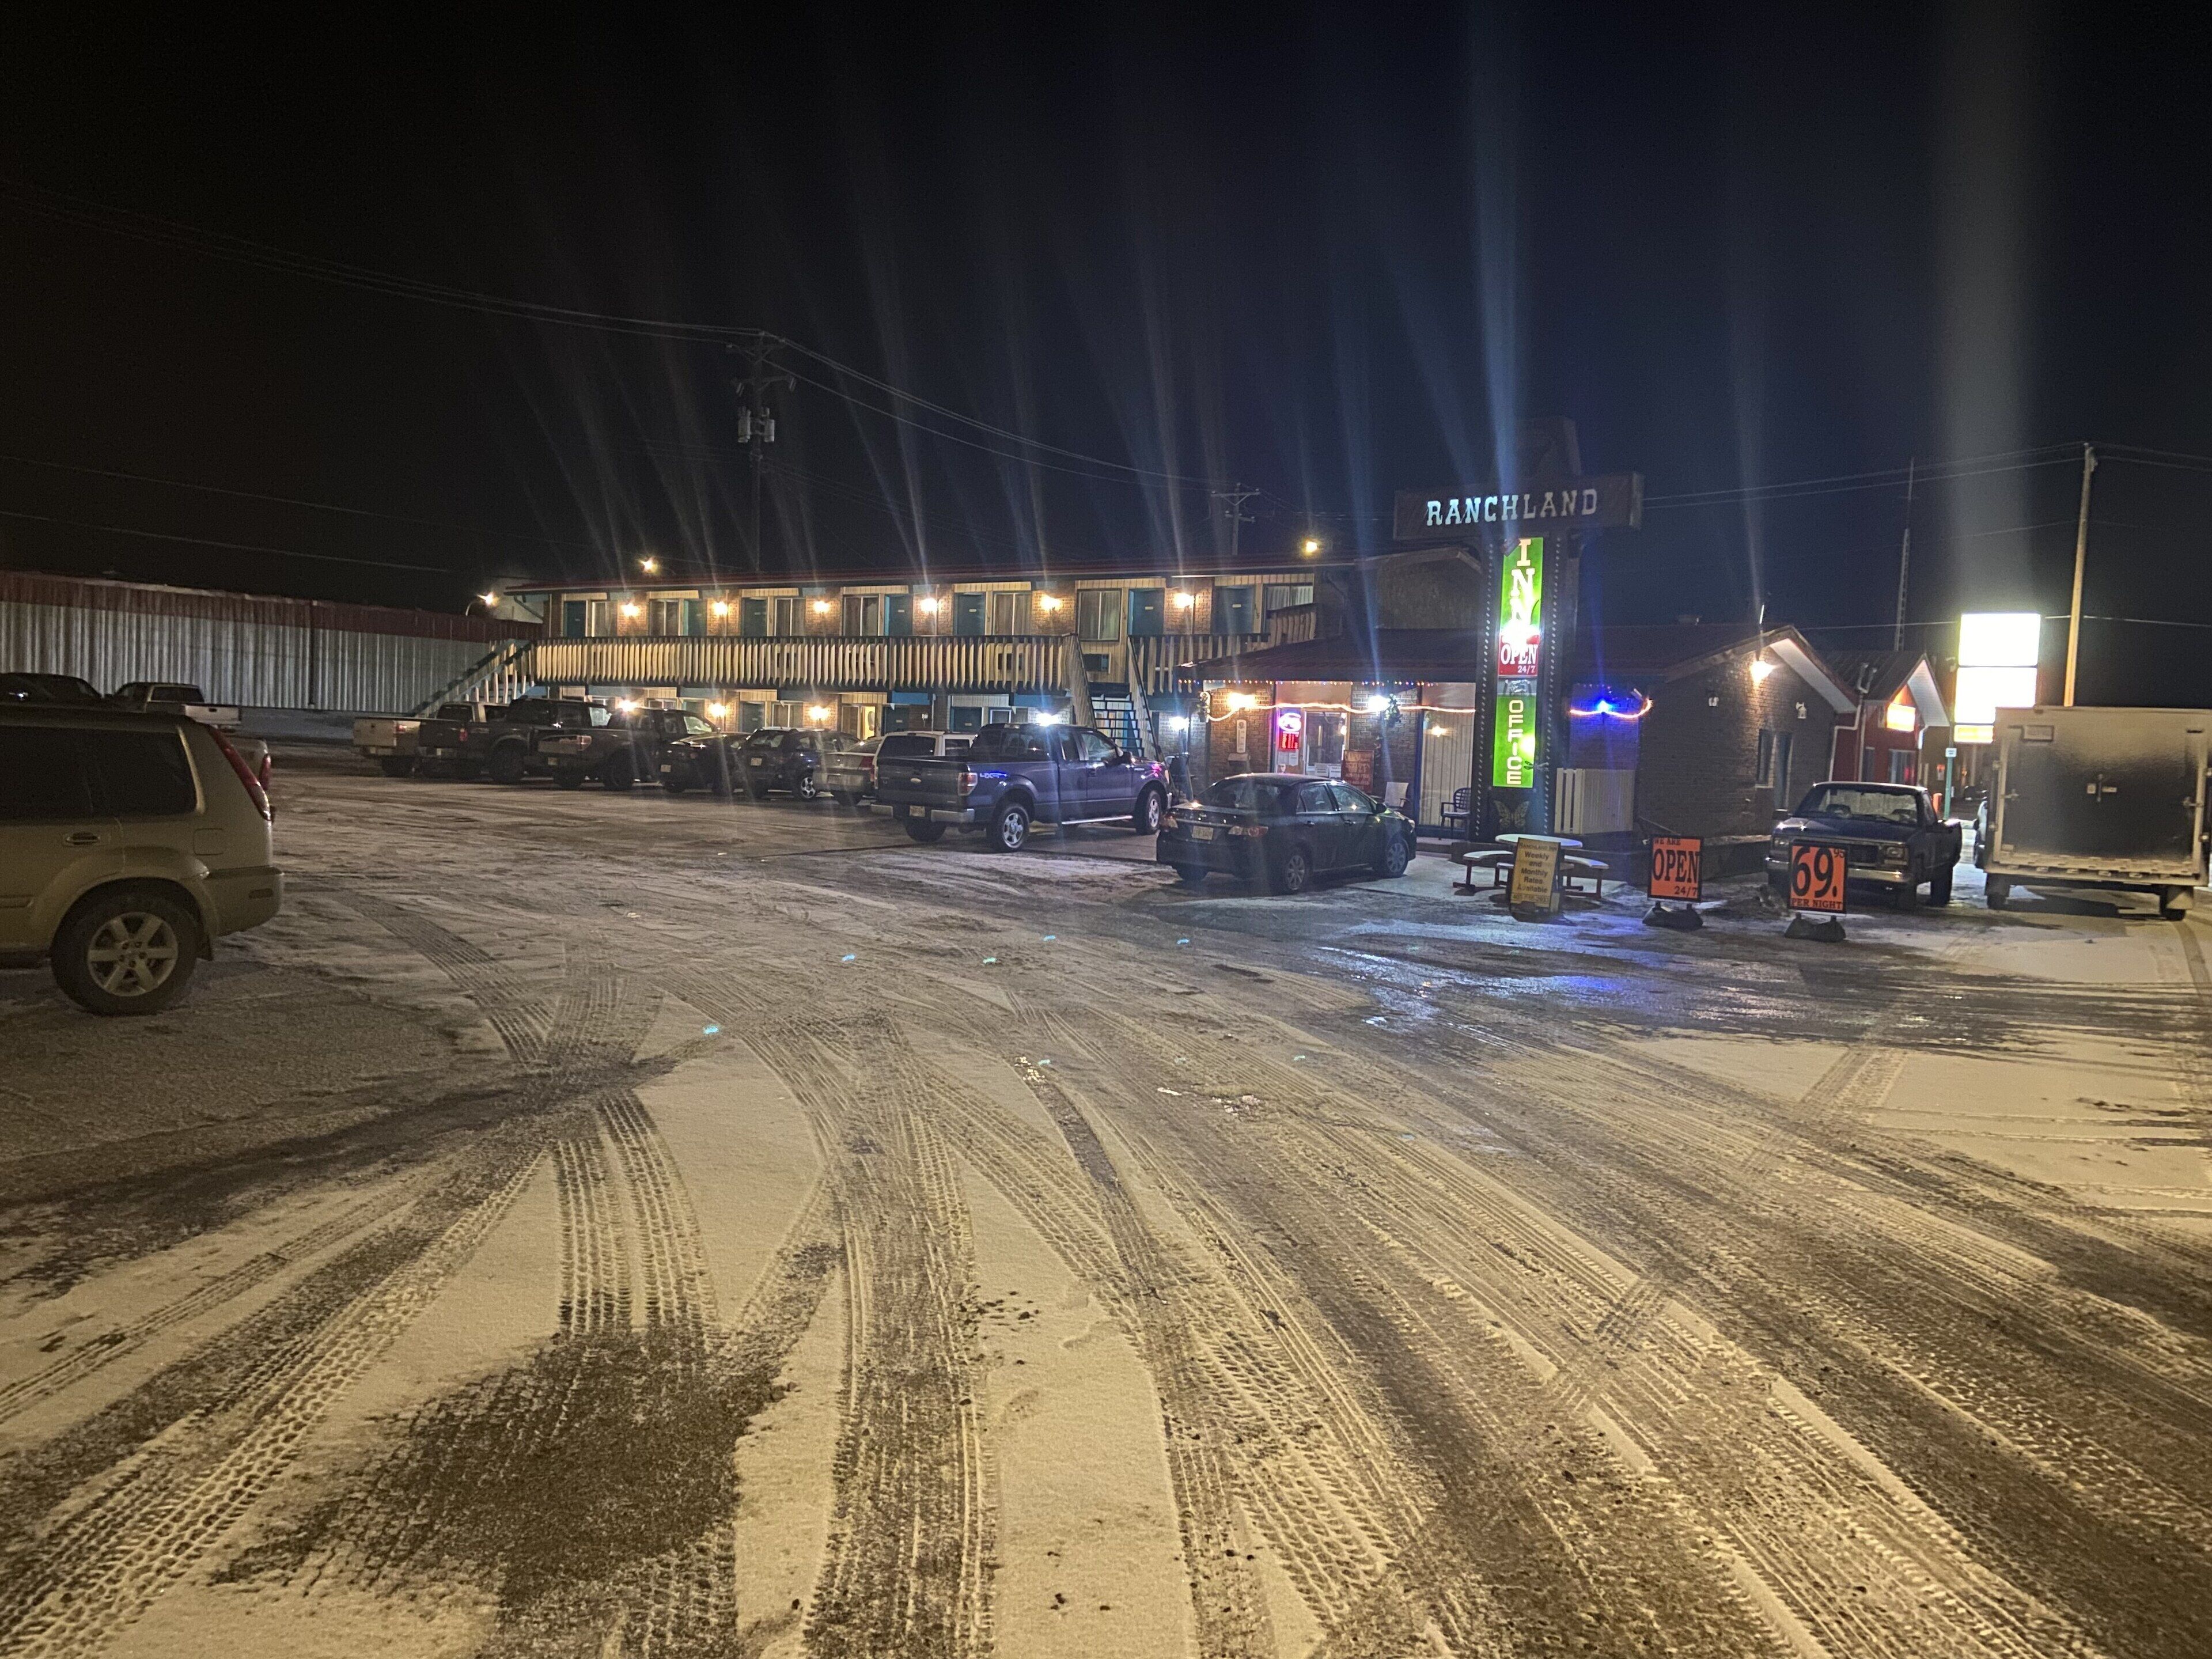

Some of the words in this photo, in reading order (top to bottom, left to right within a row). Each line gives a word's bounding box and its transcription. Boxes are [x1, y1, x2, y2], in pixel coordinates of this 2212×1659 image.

[1426, 488, 1598, 526] RANCHLAND
[1509, 538, 1536, 626] INN
[1500, 643, 1539, 665] OPEN
[1517, 665, 1536, 674] 24/7
[1506, 699, 1524, 785] OFFICE
[1666, 837, 1681, 846] ARE
[1524, 851, 1550, 860] Weekly
[1653, 848, 1701, 884] OPEN
[1521, 868, 1548, 878] Monthly
[1524, 876, 1543, 884] Rates
[1517, 884, 1548, 893] Available
[1674, 886, 1698, 897] 24/7
[1791, 899, 1809, 907] PER
[1813, 900, 1842, 909] NIGHT
